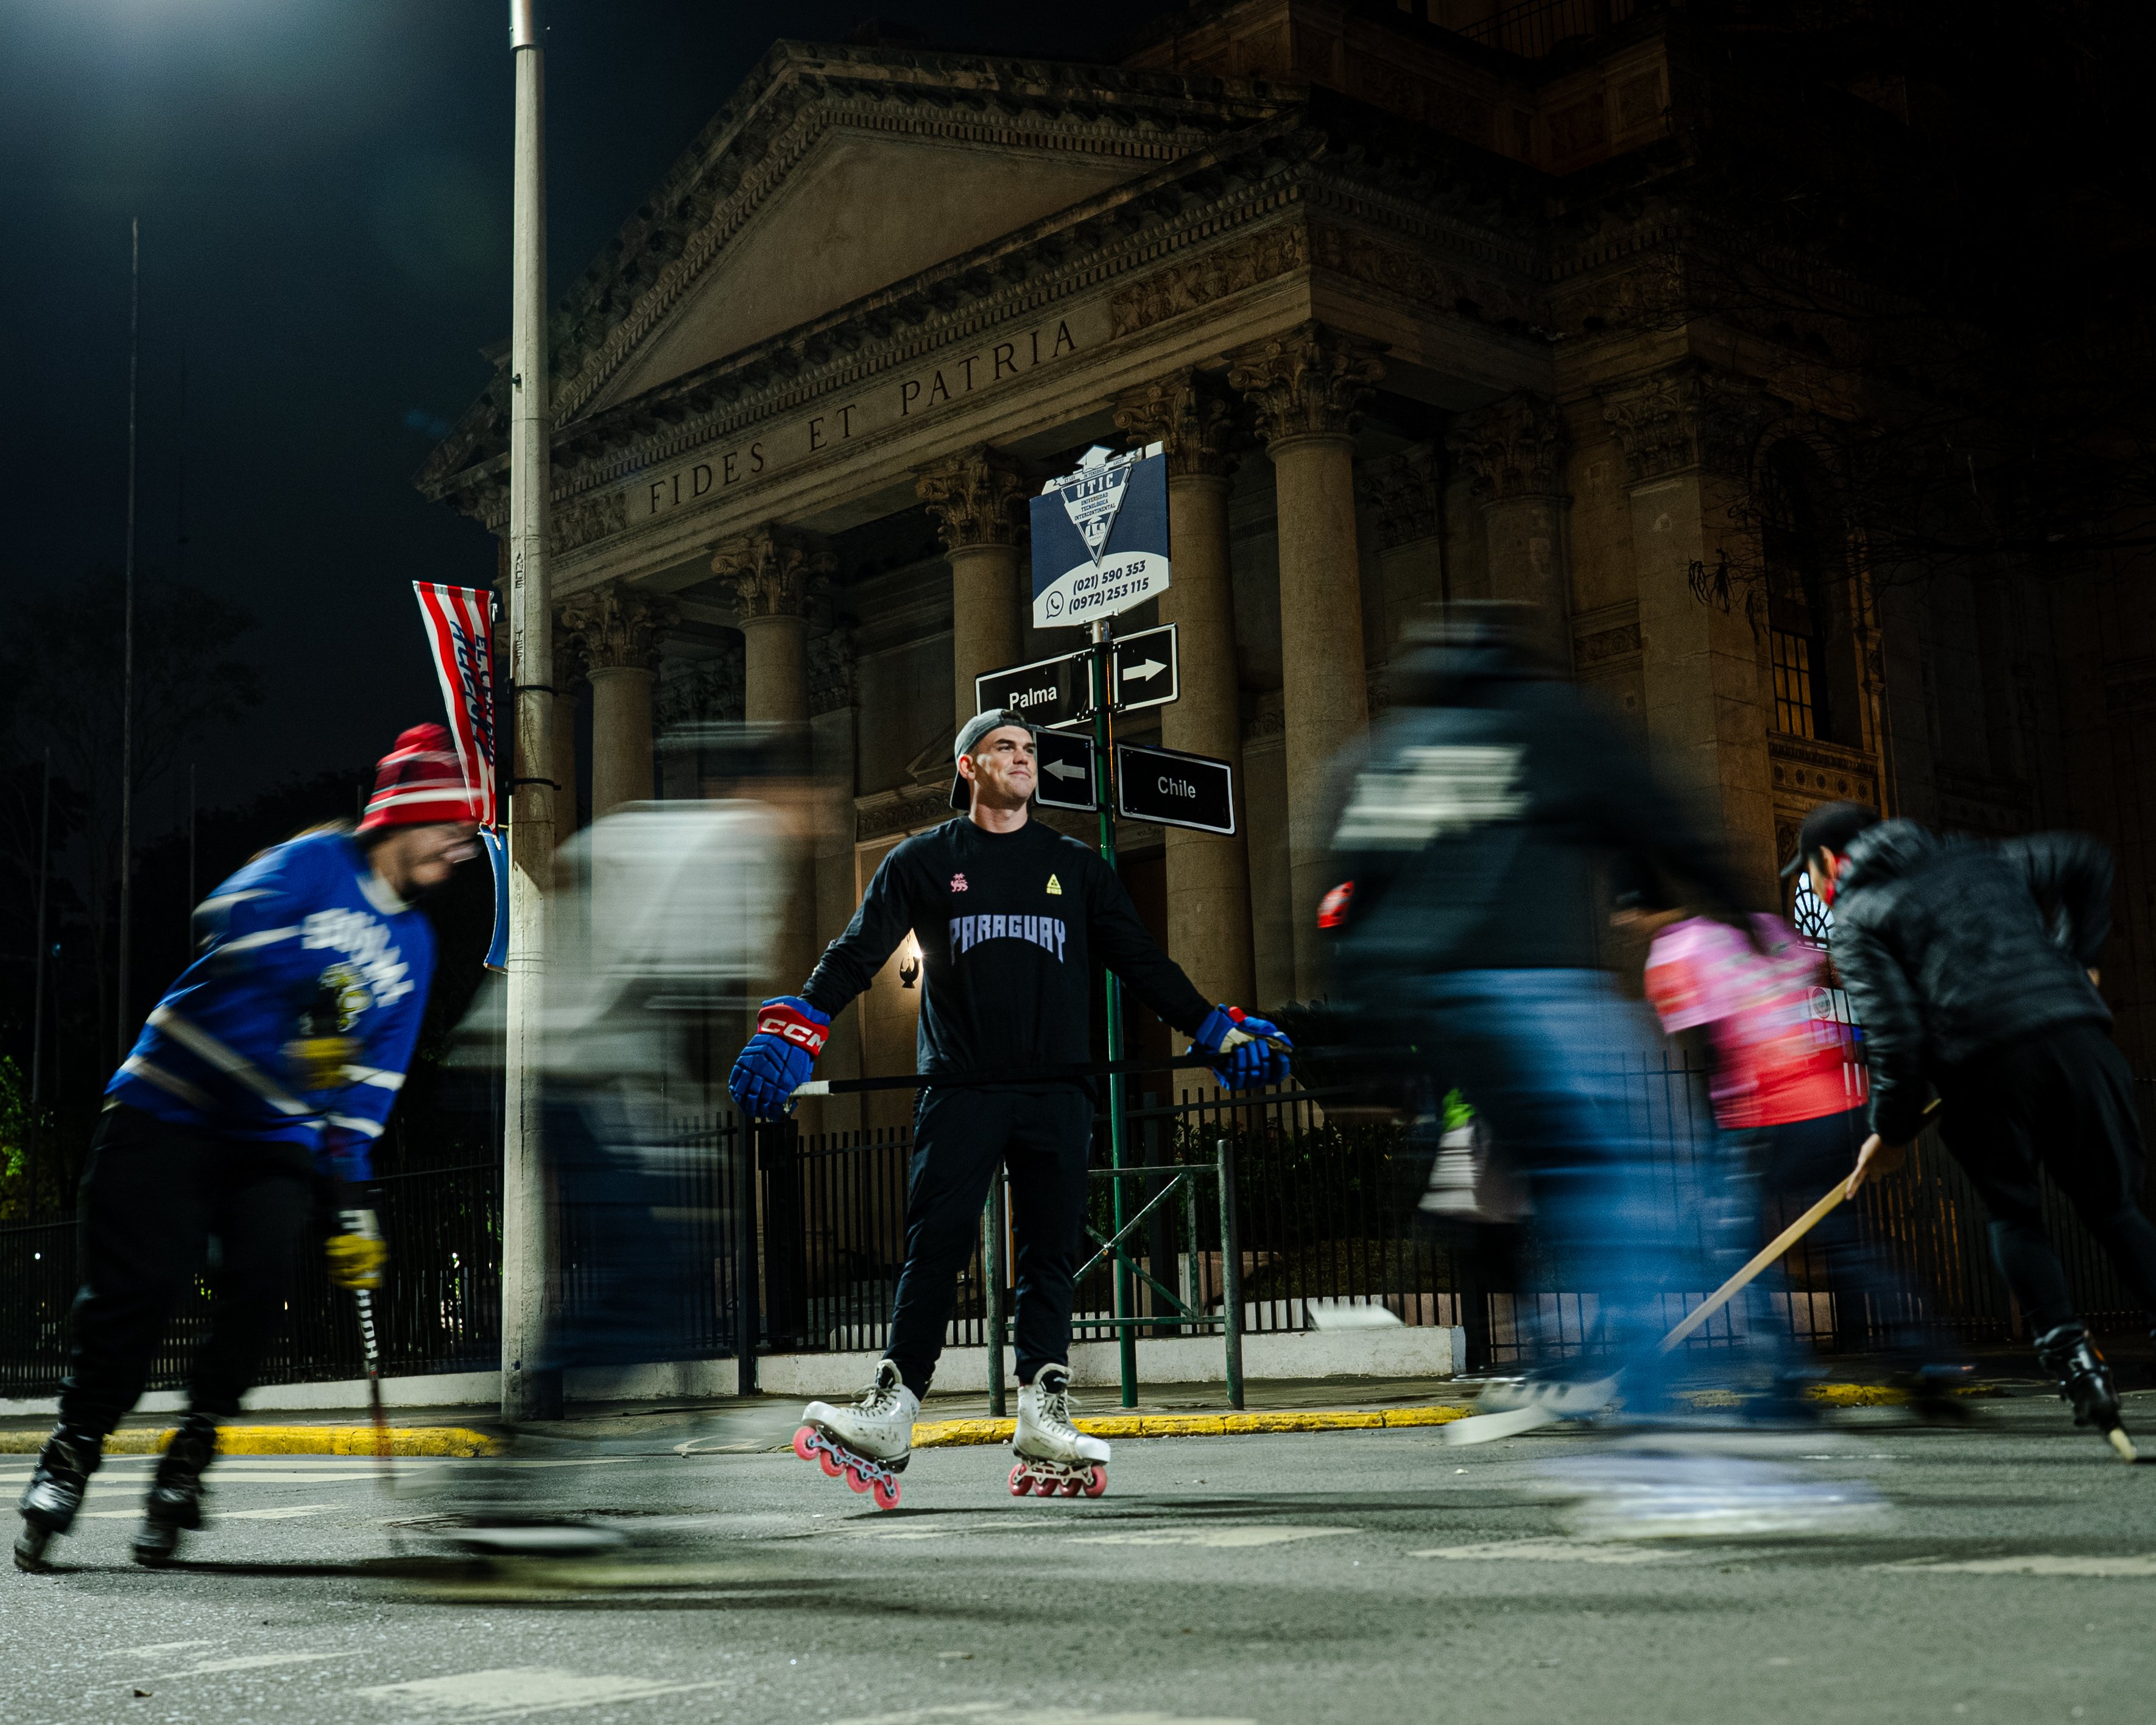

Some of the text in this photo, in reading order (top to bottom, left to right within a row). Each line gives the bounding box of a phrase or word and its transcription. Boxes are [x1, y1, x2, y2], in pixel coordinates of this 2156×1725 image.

[648, 320, 1077, 514] FIDES ET PATRIA
[1077, 473, 1113, 498] UTIC
[1081, 492, 1108, 506] UNIVERSIDAD
[1074, 503, 1116, 521] INTERCONTINENTAL
[1073, 559, 1146, 595] (021) 590 353
[1069, 577, 1149, 615] (0972) 253 115
[1009, 686, 1057, 711] Palma
[1157, 776, 1196, 799] Chile
[949, 915, 1066, 966] PARAGUAY
[761, 1018, 826, 1053] CCM
